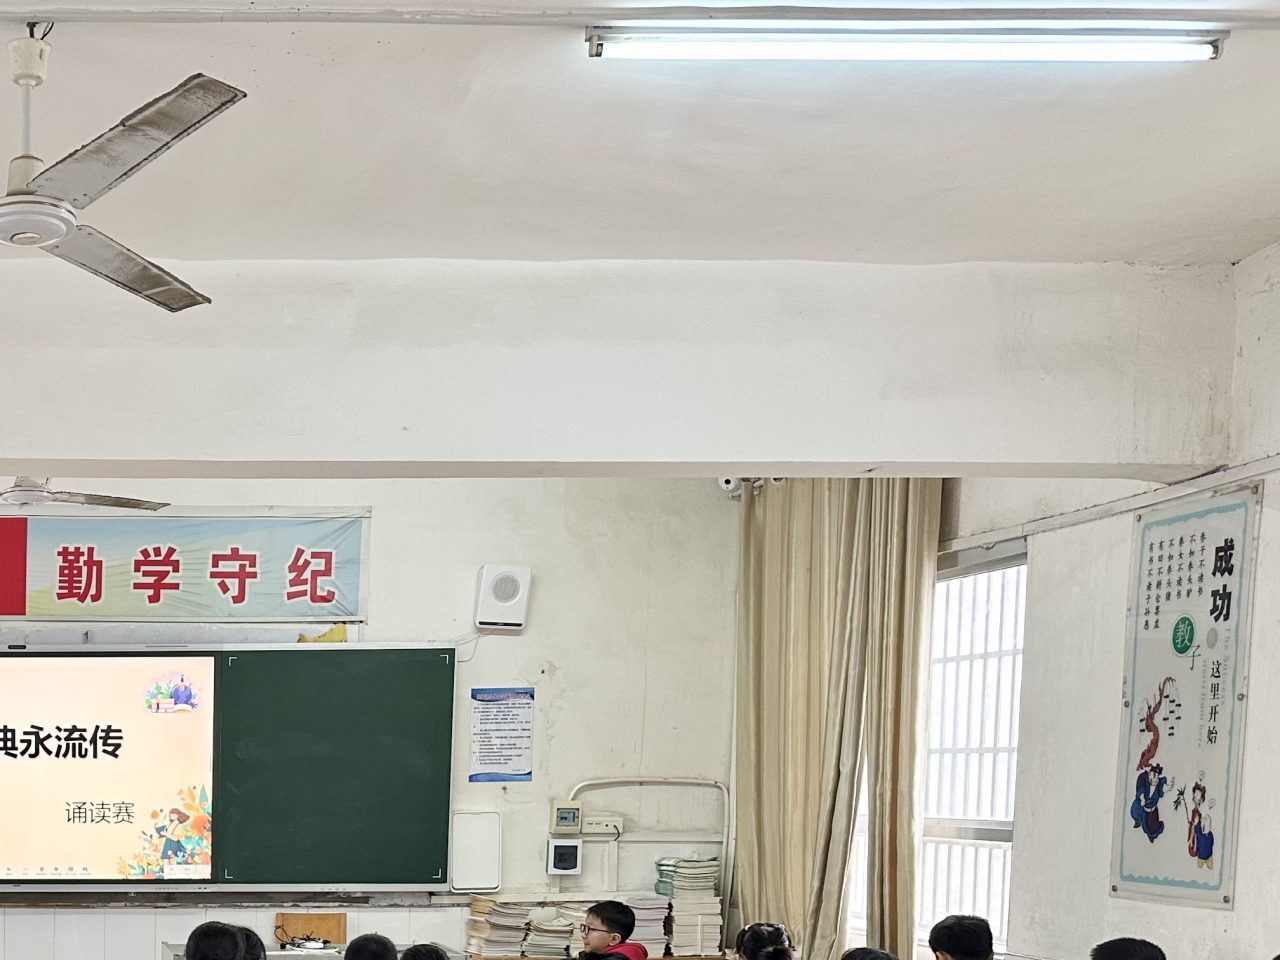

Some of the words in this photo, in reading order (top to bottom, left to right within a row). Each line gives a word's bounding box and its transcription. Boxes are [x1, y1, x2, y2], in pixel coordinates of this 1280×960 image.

[56, 545, 336, 604] 勤学守纪
[1209, 537, 1234, 623] 成功
[1175, 619, 1201, 671] 教子
[1206, 660, 1222, 745] 这里开始
[65, 801, 136, 824] 诵读赛
